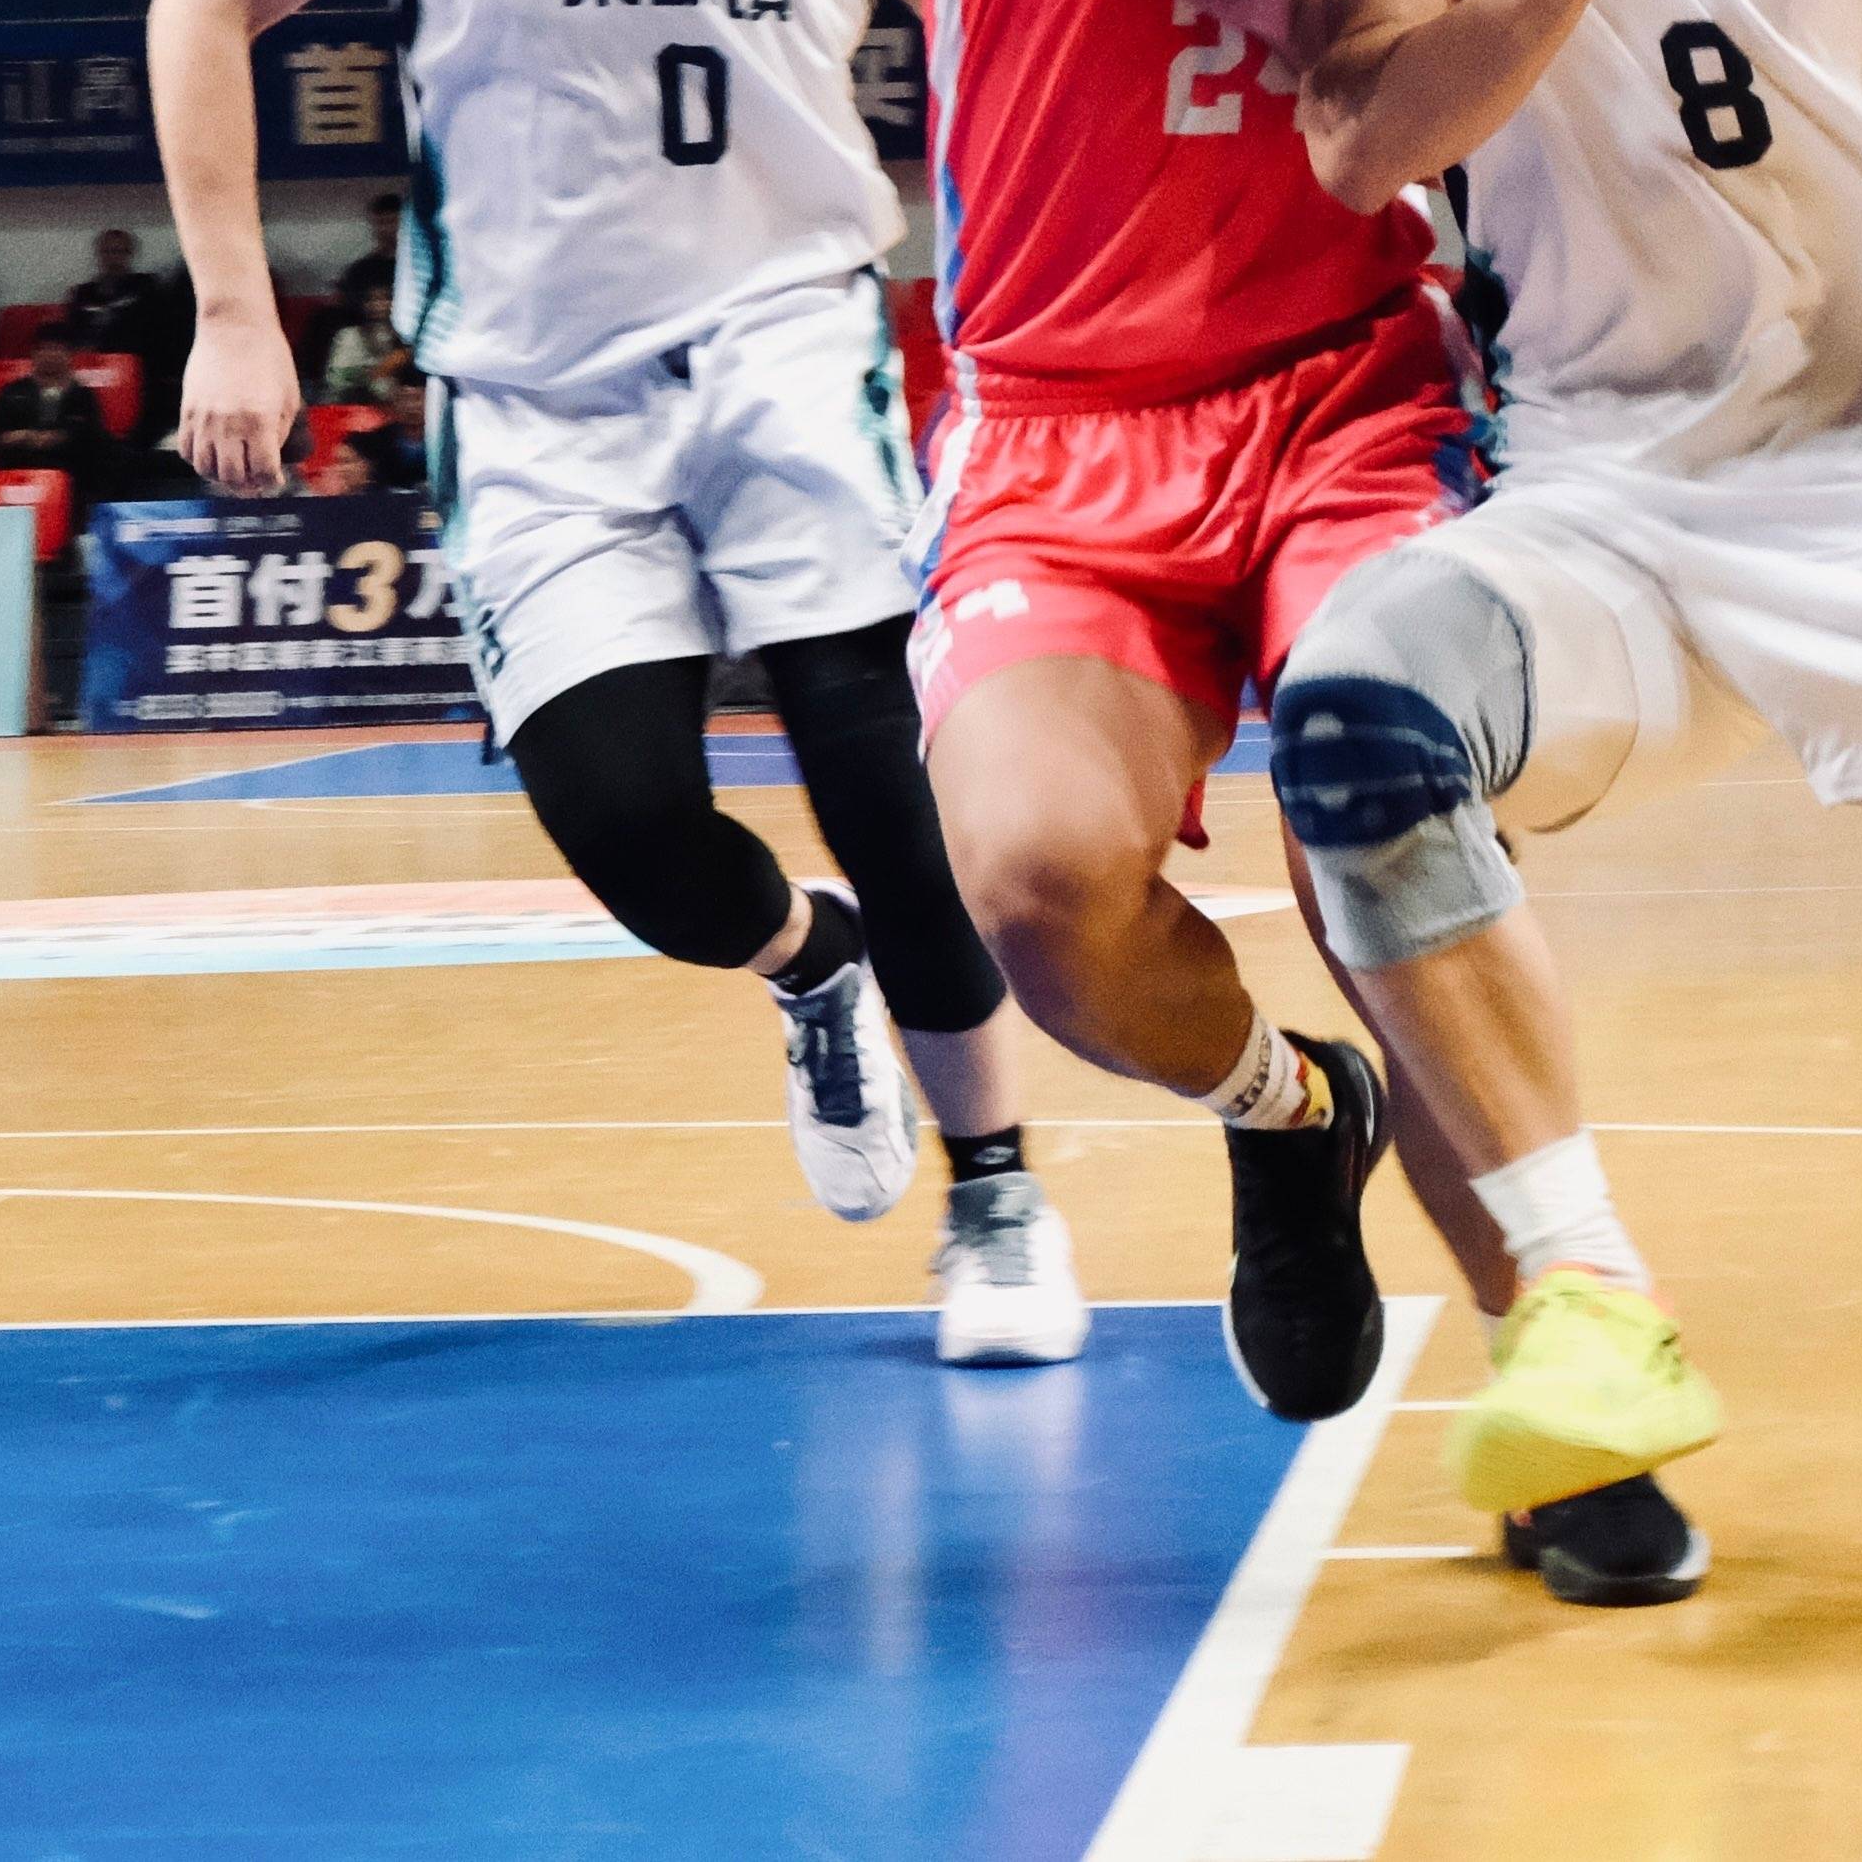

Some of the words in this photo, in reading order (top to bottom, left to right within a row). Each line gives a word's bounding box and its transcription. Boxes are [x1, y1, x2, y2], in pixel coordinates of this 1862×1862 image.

[281, 42, 393, 145] 首
[655, 42, 730, 166] 0
[1658, 19, 1774, 171] 8
